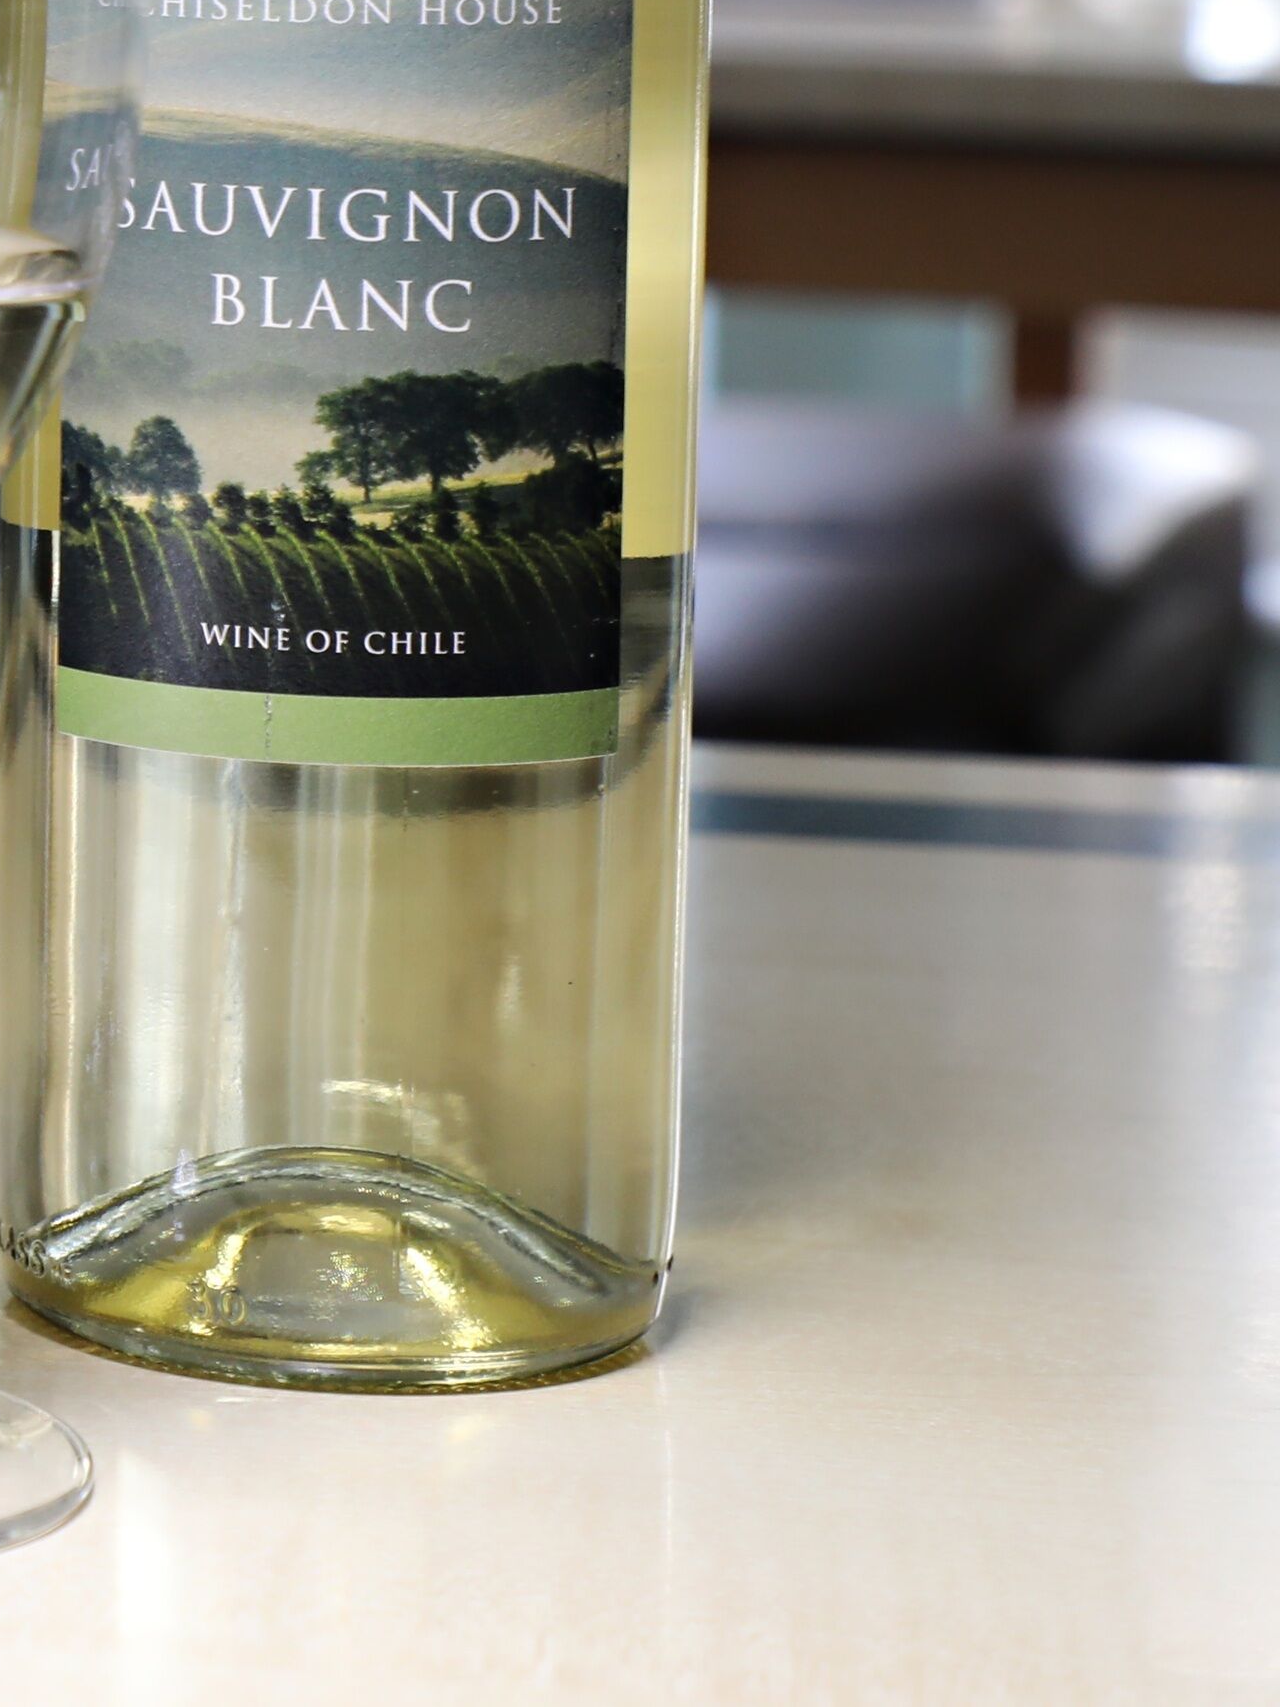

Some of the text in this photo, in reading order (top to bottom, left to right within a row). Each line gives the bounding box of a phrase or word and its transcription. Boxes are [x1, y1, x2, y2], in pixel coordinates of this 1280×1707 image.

[115, 176, 577, 243] SAUVIGNON
[210, 271, 474, 334] BLANC
[200, 620, 468, 657] WINE OF CHILE
